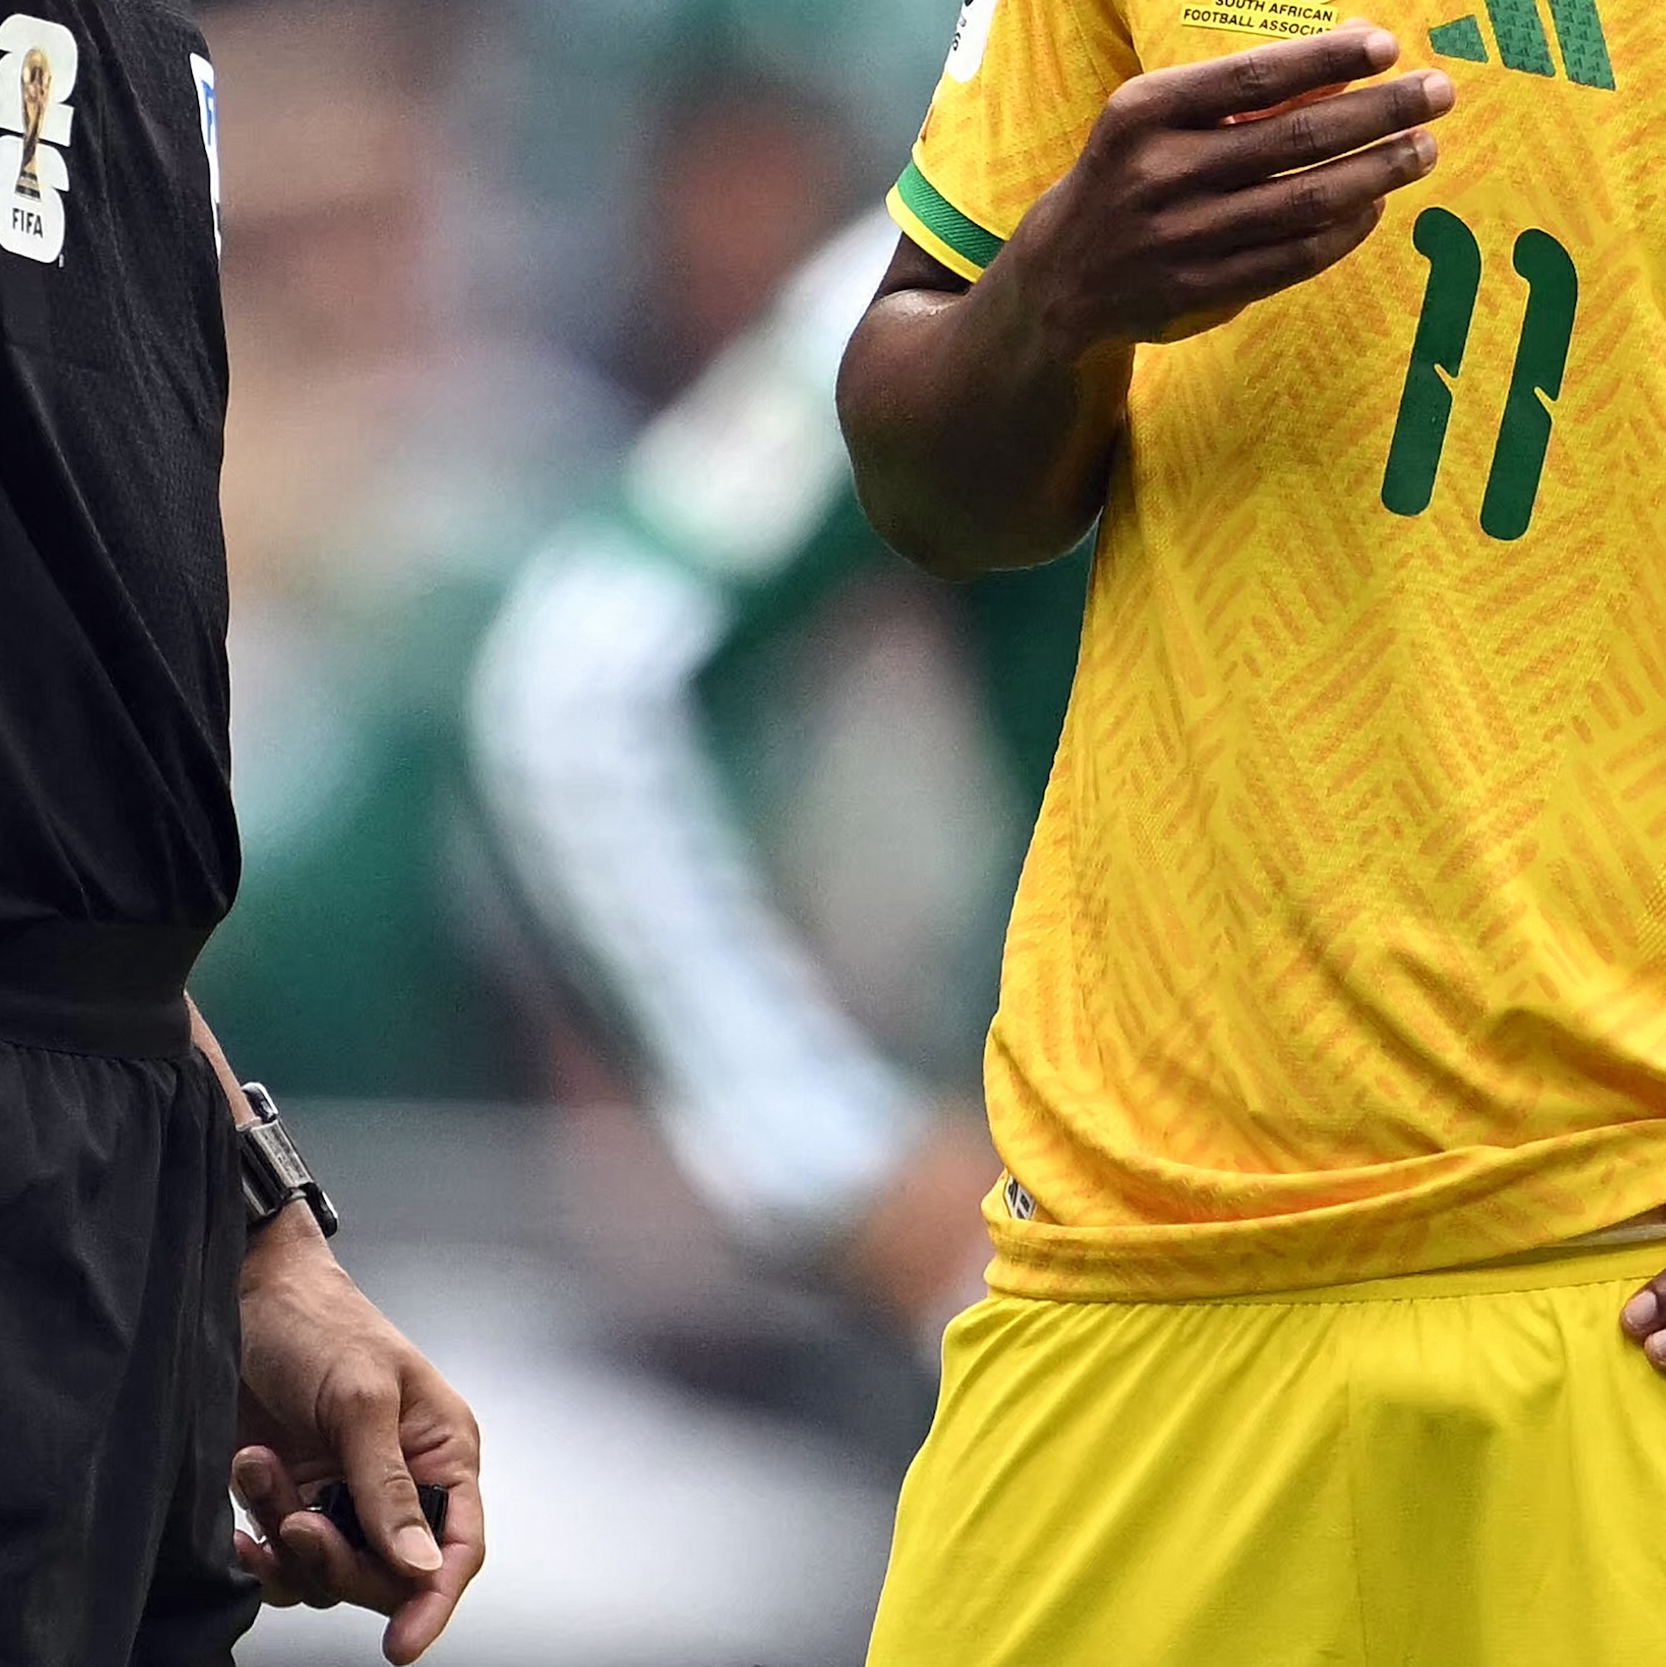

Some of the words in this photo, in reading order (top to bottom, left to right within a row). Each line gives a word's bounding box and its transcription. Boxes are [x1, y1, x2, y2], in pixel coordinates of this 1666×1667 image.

[1183, 8, 1254, 28] FOOTBALL
[1268, 2, 1334, 22] AFRICAN
[11, 207, 44, 239] FIFA
[1381, 207, 1579, 542] 11
